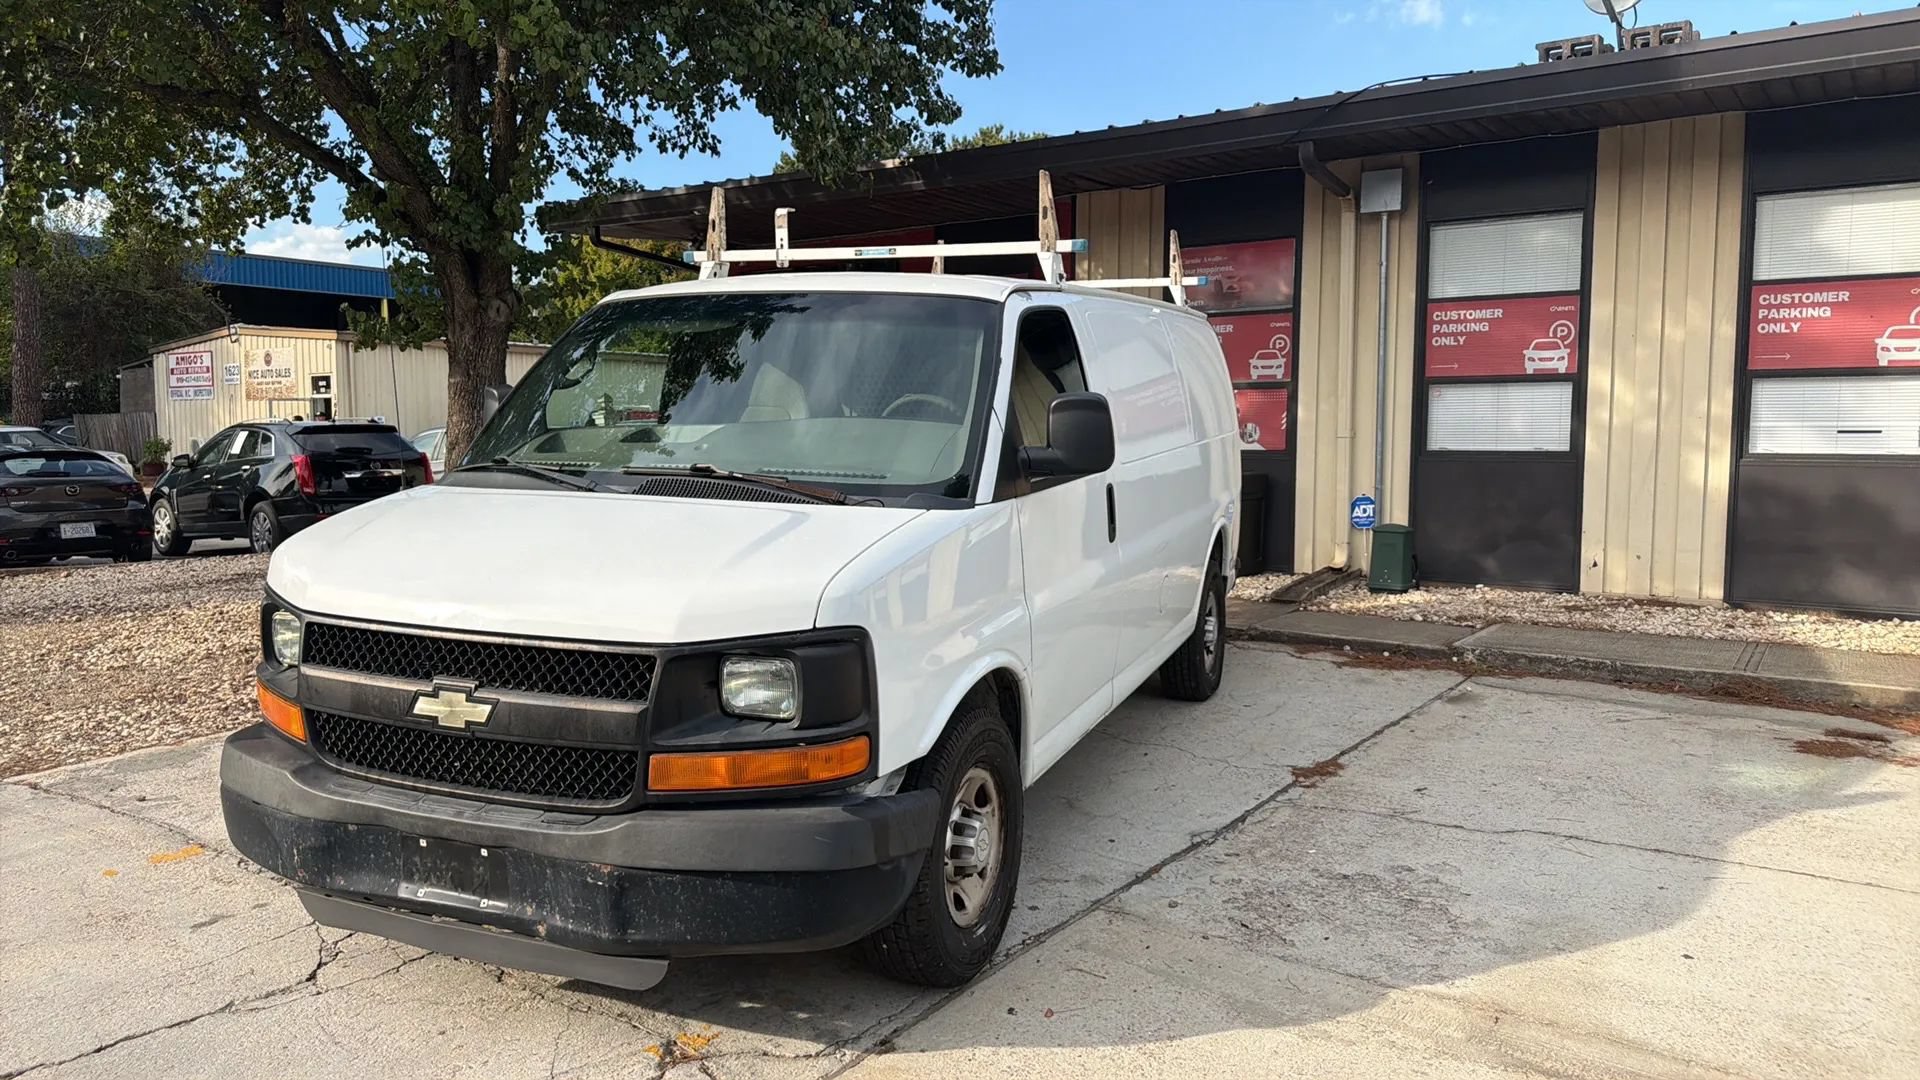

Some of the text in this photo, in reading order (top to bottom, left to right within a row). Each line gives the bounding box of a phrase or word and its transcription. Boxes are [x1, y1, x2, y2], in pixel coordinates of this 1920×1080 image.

[1759, 291, 1850, 305] CUSTOMER
[1432, 308, 1504, 321] CUSTOMER
[1758, 306, 1832, 319] PARKING
[1432, 322, 1489, 334] PARKING
[1557, 327, 1568, 338] P
[1757, 321, 1802, 334] ONLY
[1275, 339, 1285, 350] P
[1431, 335, 1467, 346] ONLY
[176, 355, 204, 366] AMIGO'S
[224, 365, 240, 377] 1623
[248, 368, 291, 380] NICE AUTO SALES
[1352, 504, 1375, 518] ADT
